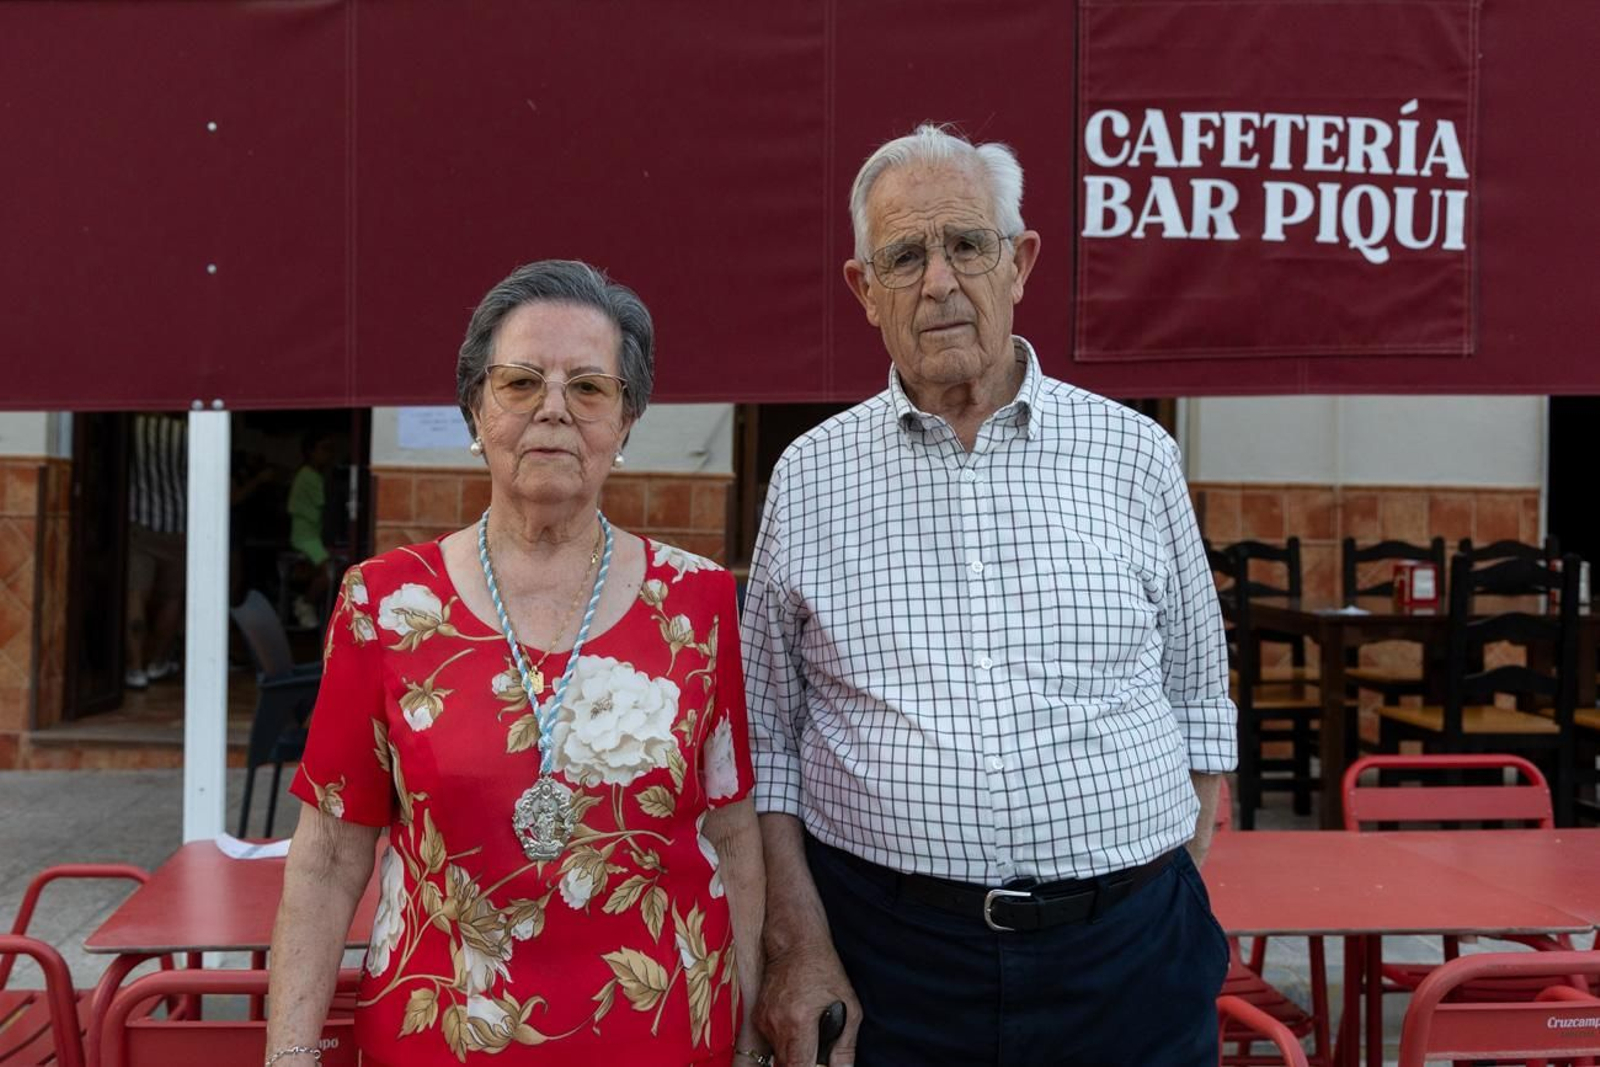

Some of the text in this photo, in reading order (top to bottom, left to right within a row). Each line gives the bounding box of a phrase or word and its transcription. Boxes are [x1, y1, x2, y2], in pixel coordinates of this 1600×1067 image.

[1084, 99, 1469, 179] CAFETERÍA
[1081, 175, 1469, 264] BAR PIQUI
